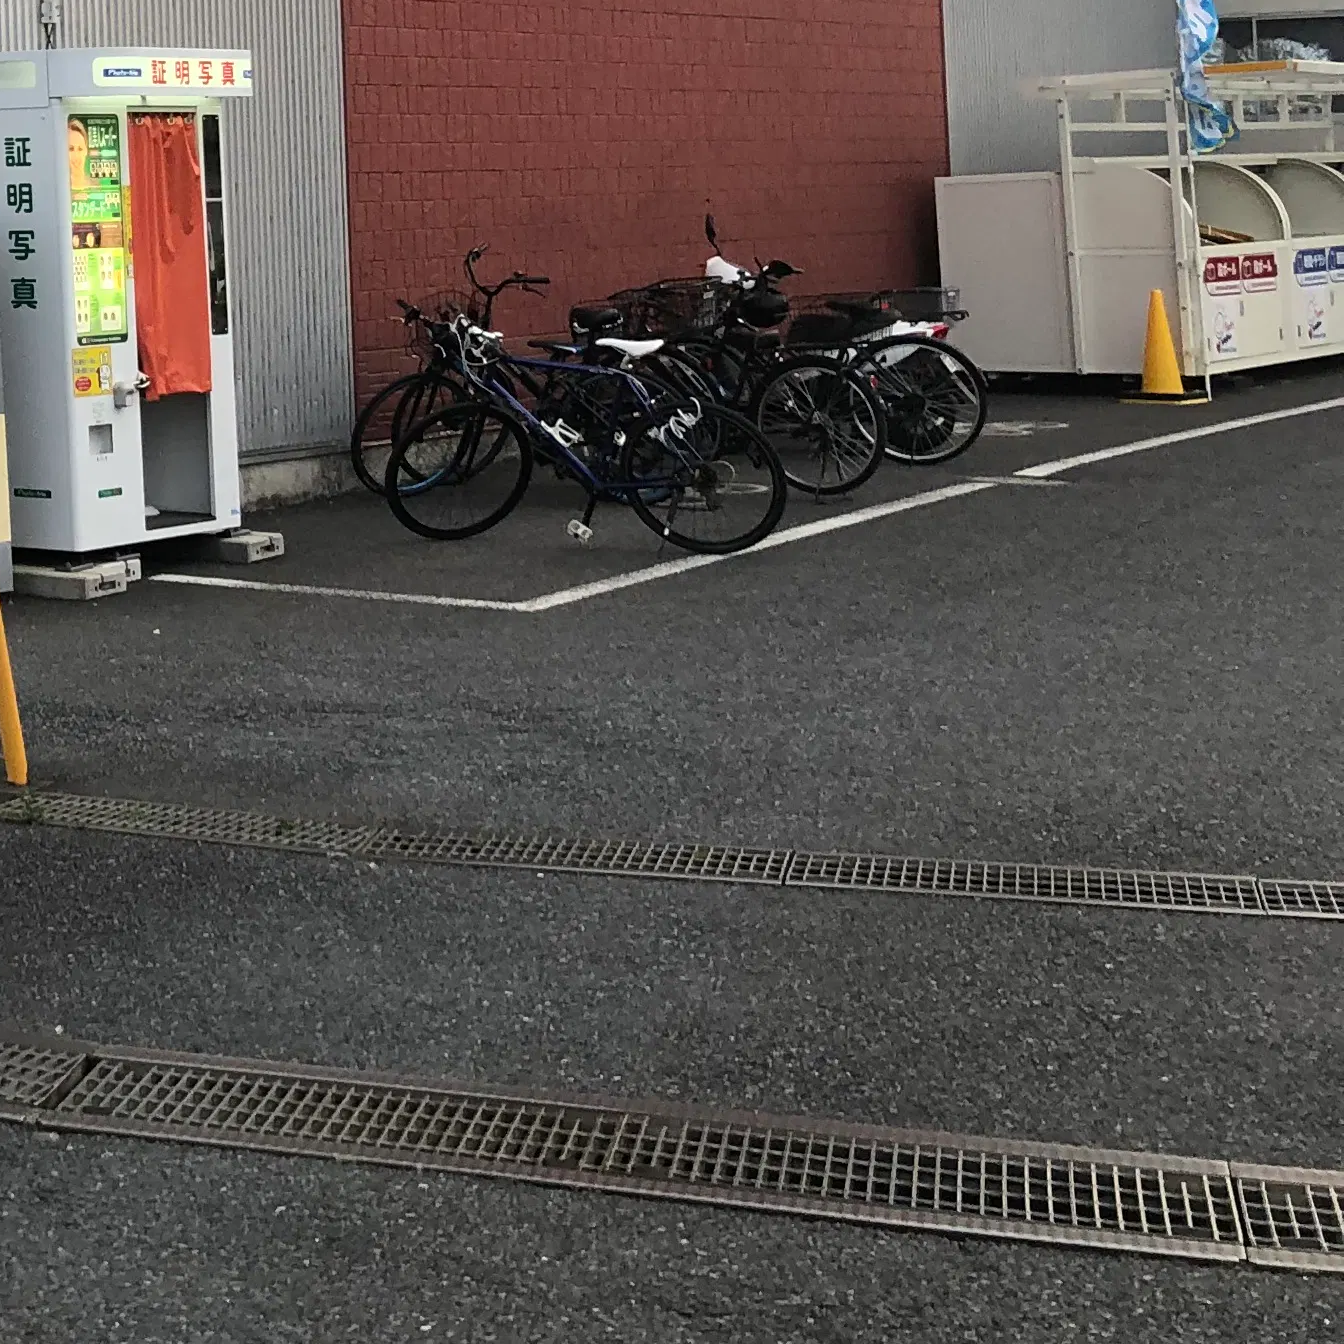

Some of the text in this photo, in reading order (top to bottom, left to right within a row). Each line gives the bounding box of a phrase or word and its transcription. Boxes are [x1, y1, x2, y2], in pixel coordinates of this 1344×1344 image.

[151, 60, 235, 85] 証明写真
[4, 137, 37, 309] 証明写真
